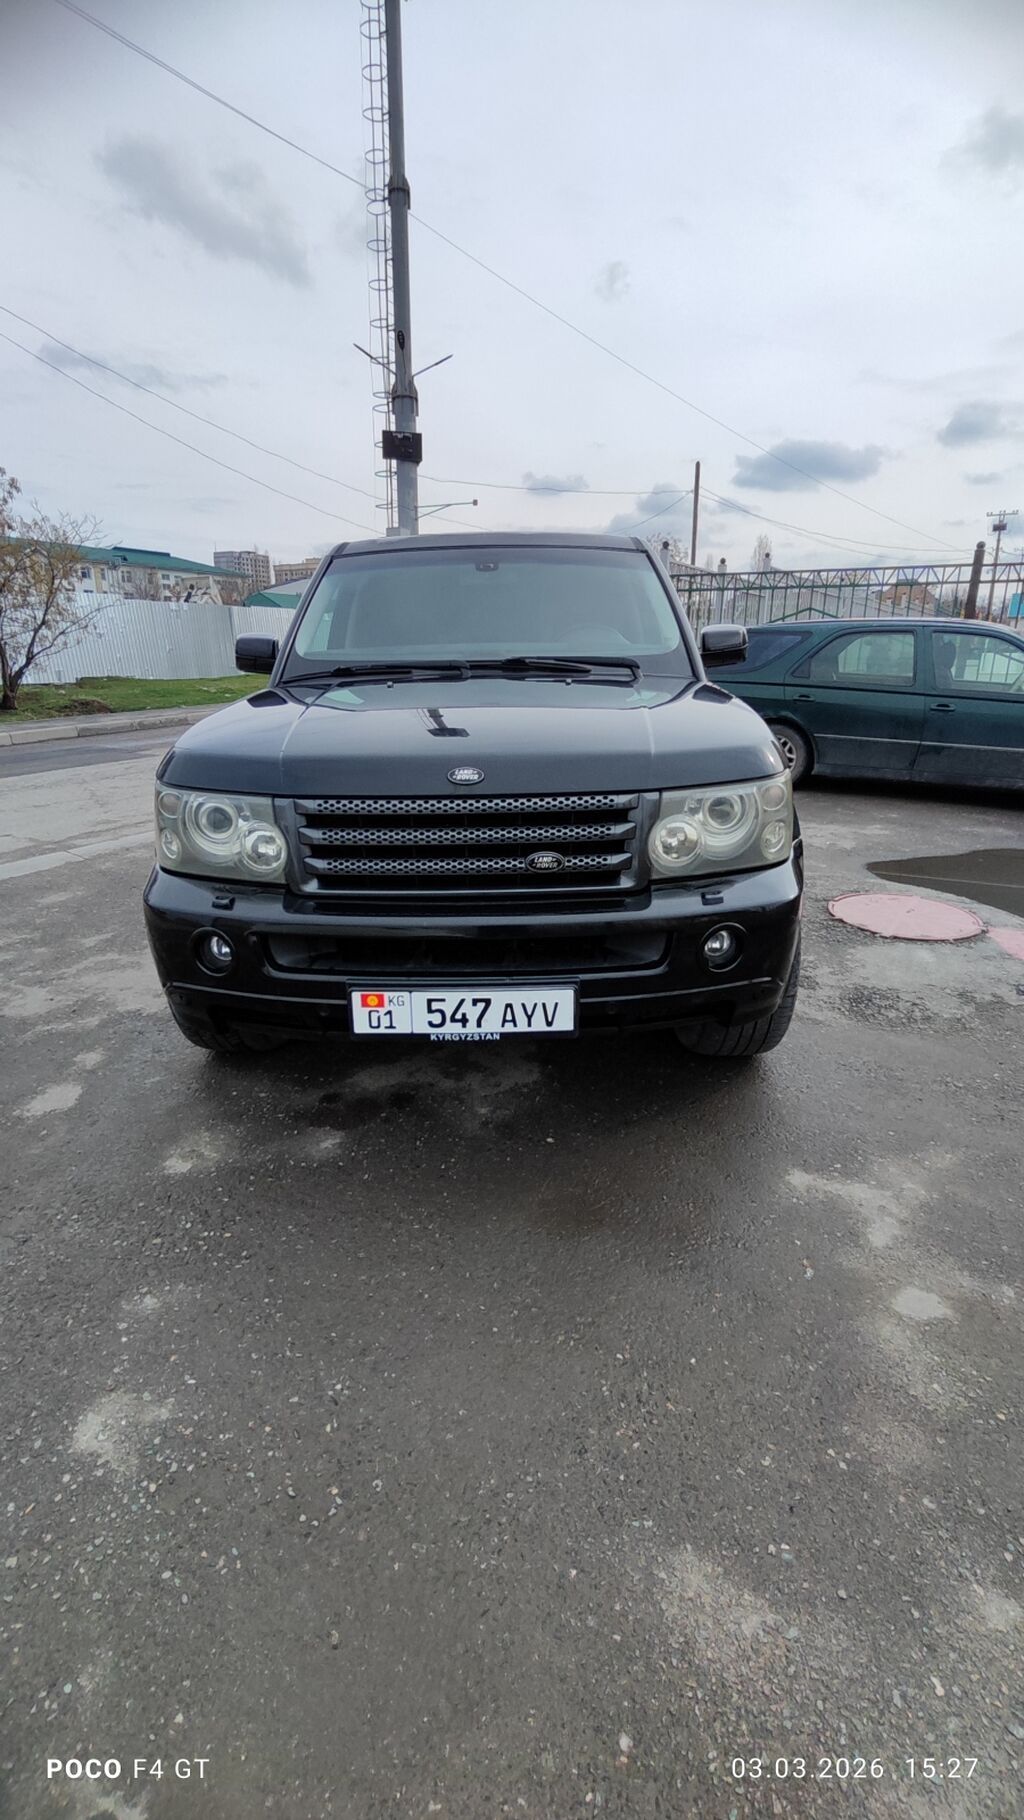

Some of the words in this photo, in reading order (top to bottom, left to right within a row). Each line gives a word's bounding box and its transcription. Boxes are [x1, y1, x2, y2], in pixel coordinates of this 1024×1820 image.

[388, 995, 405, 1007] KG
[368, 1010, 397, 1029] 01
[426, 998, 492, 1028] 547
[501, 1002, 559, 1028] AYV
[430, 1033, 500, 1041] KYRGYZSTAN
